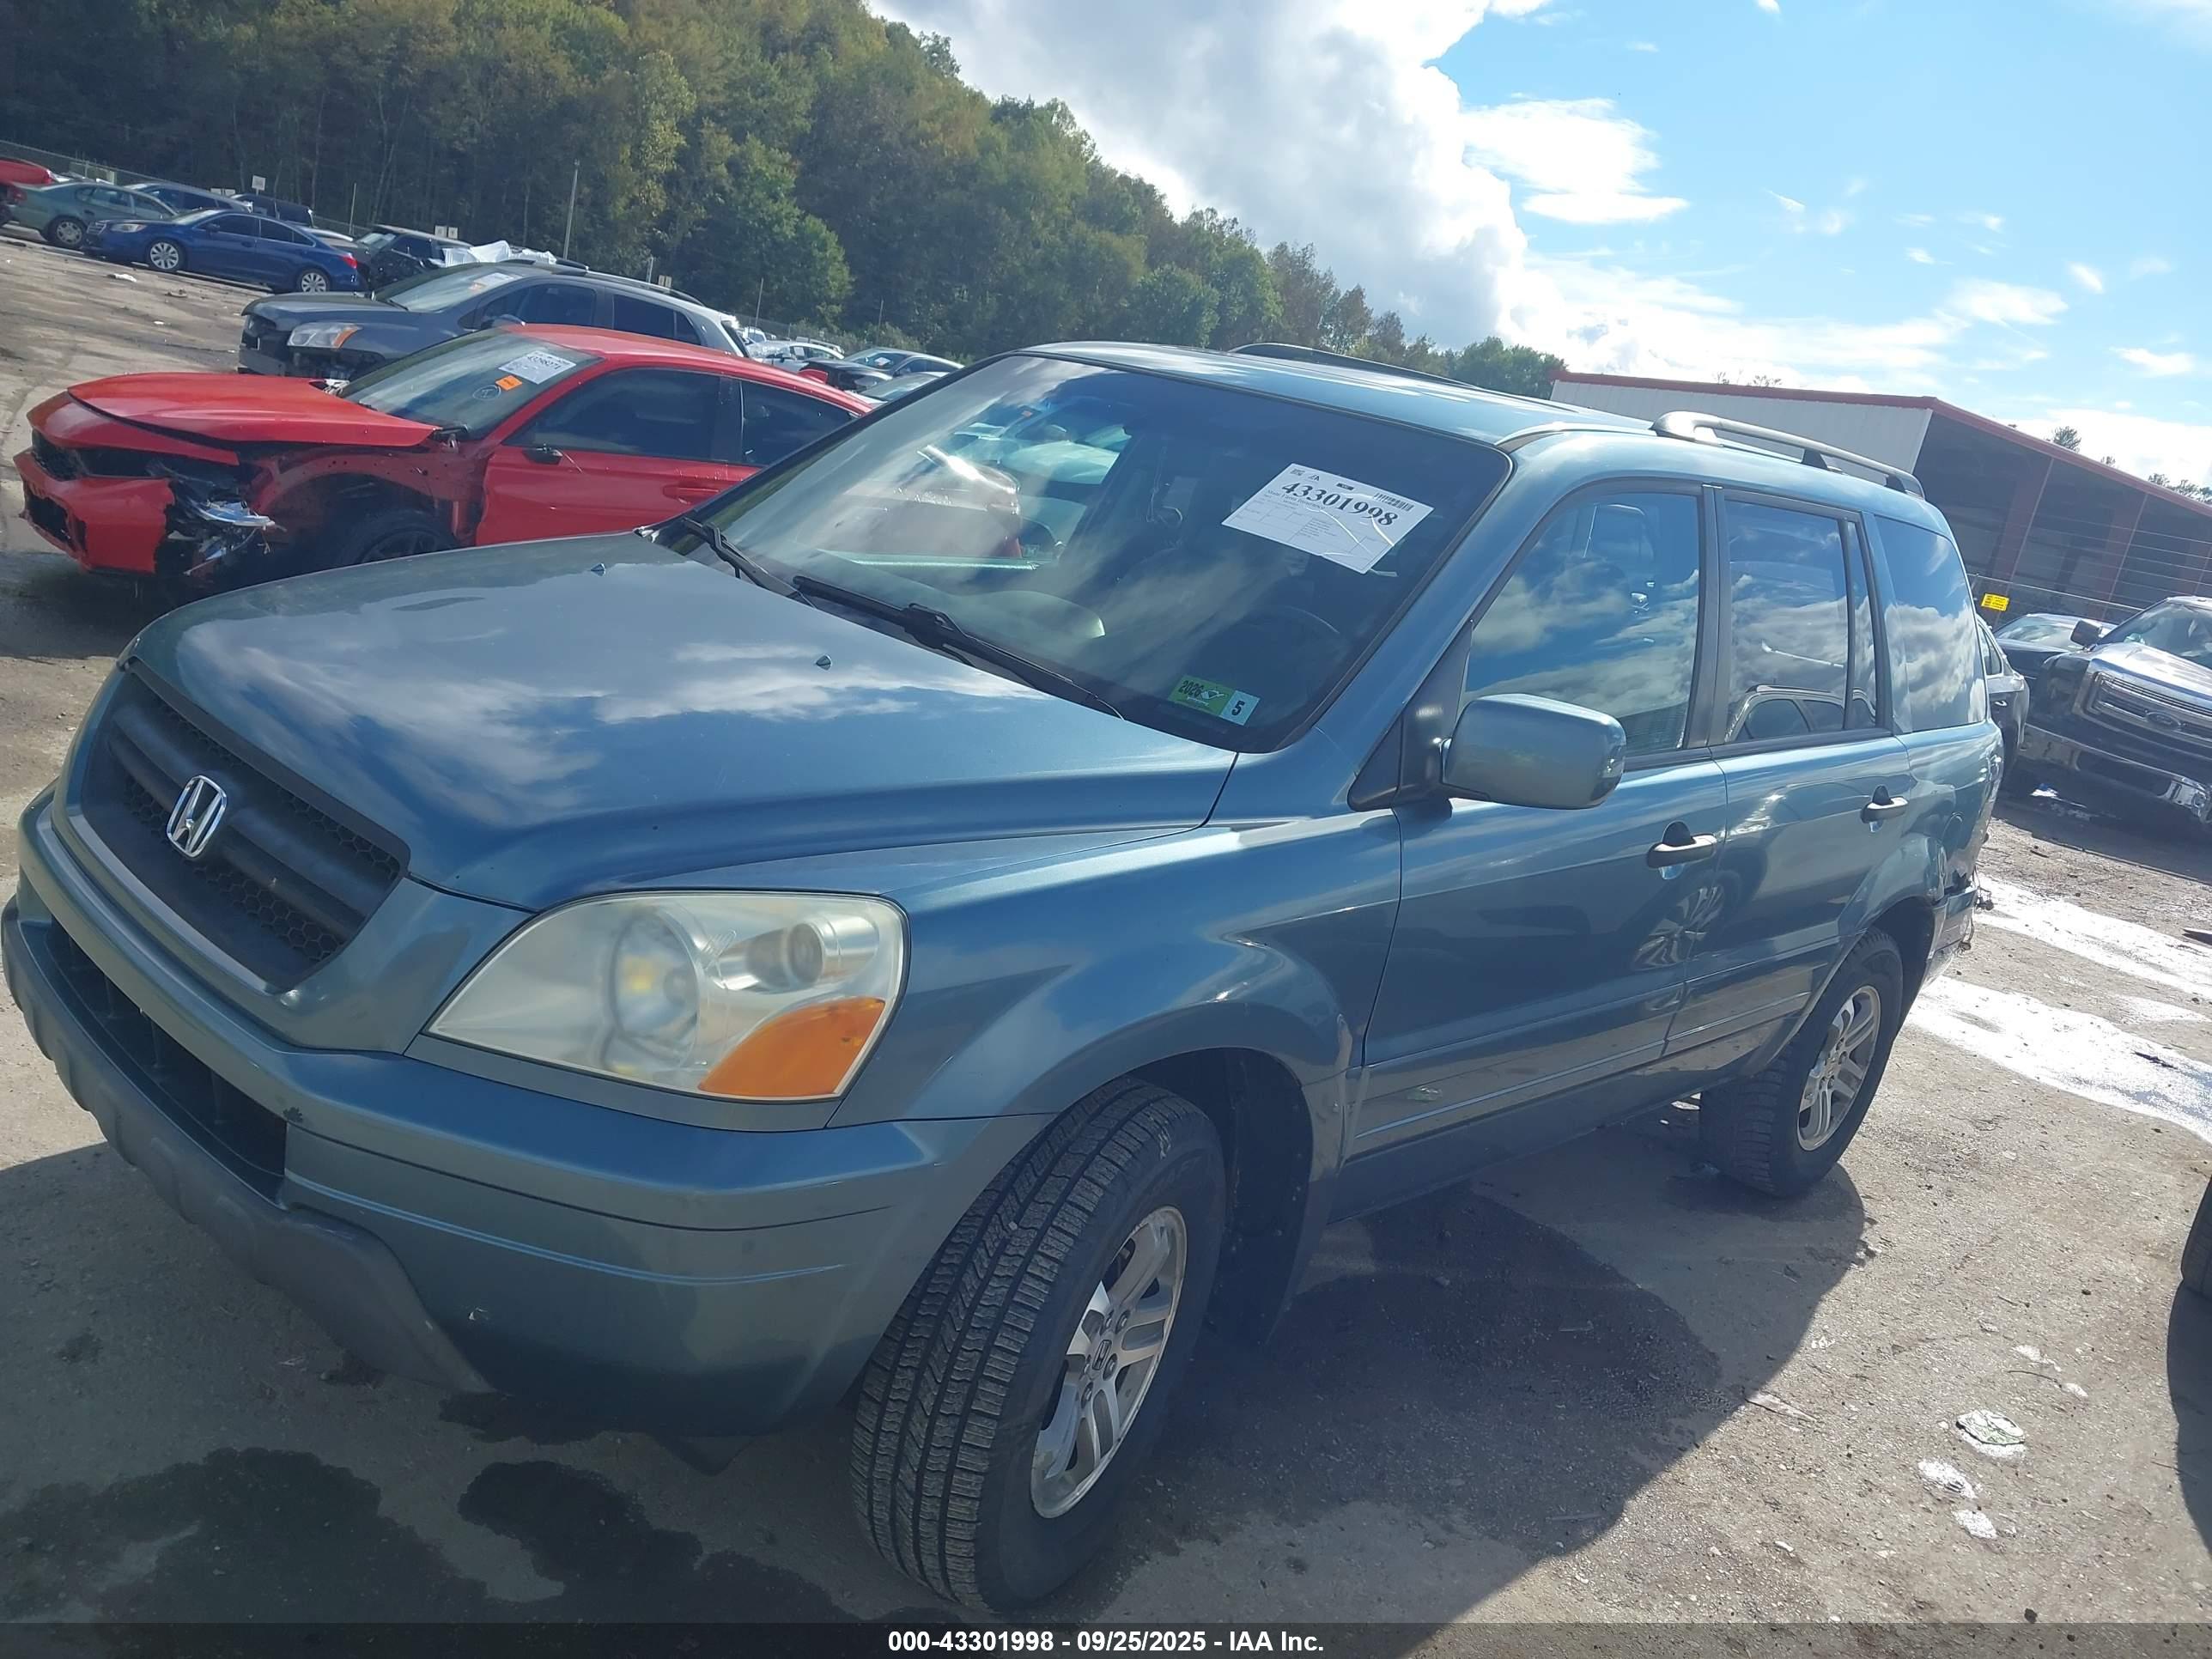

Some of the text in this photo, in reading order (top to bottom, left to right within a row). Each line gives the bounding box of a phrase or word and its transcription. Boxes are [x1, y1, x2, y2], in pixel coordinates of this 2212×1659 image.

[1281, 482, 1399, 526] 43301998
[1178, 680, 1204, 697] 2026
[1231, 701, 1245, 715] 5
